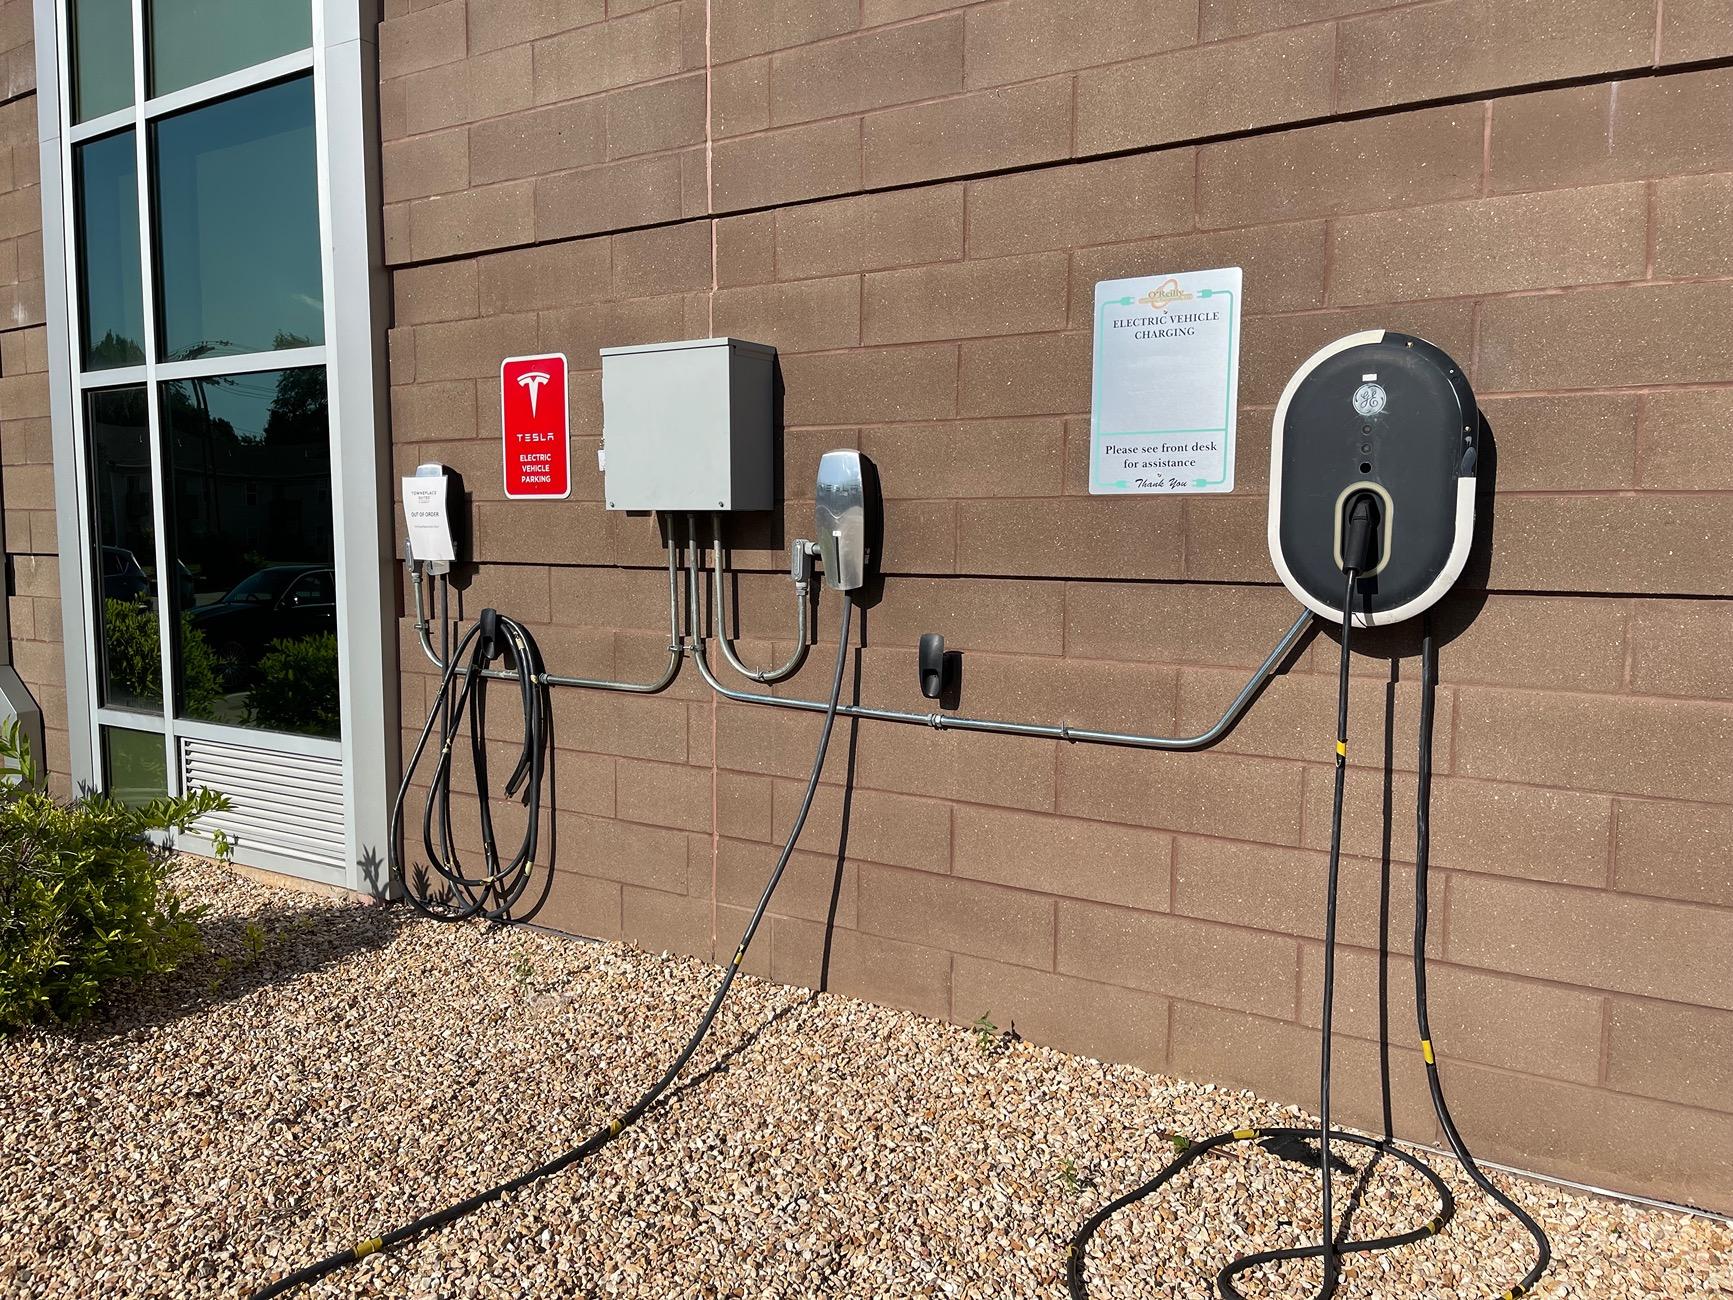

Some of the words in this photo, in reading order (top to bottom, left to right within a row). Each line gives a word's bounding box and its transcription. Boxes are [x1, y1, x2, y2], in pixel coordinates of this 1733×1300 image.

[1148, 288, 1184, 299] O'Reilly
[1113, 316, 1167, 329] ELECTRIC
[1170, 312, 1220, 323] VEHICLE
[1134, 327, 1195, 340] CHARGING
[516, 432, 554, 442] TESLA
[1105, 445, 1139, 455] Please
[1141, 446, 1159, 454] see
[1161, 443, 1188, 453] front
[1191, 442, 1217, 452] desk
[519, 453, 552, 462] ELECTRIC
[521, 464, 551, 472] VEHICLE
[1123, 459, 1139, 469] for
[1142, 458, 1196, 468] assistance
[521, 475, 551, 483] PARKING
[1135, 478, 1164, 489] Thank
[1168, 477, 1188, 489] You
